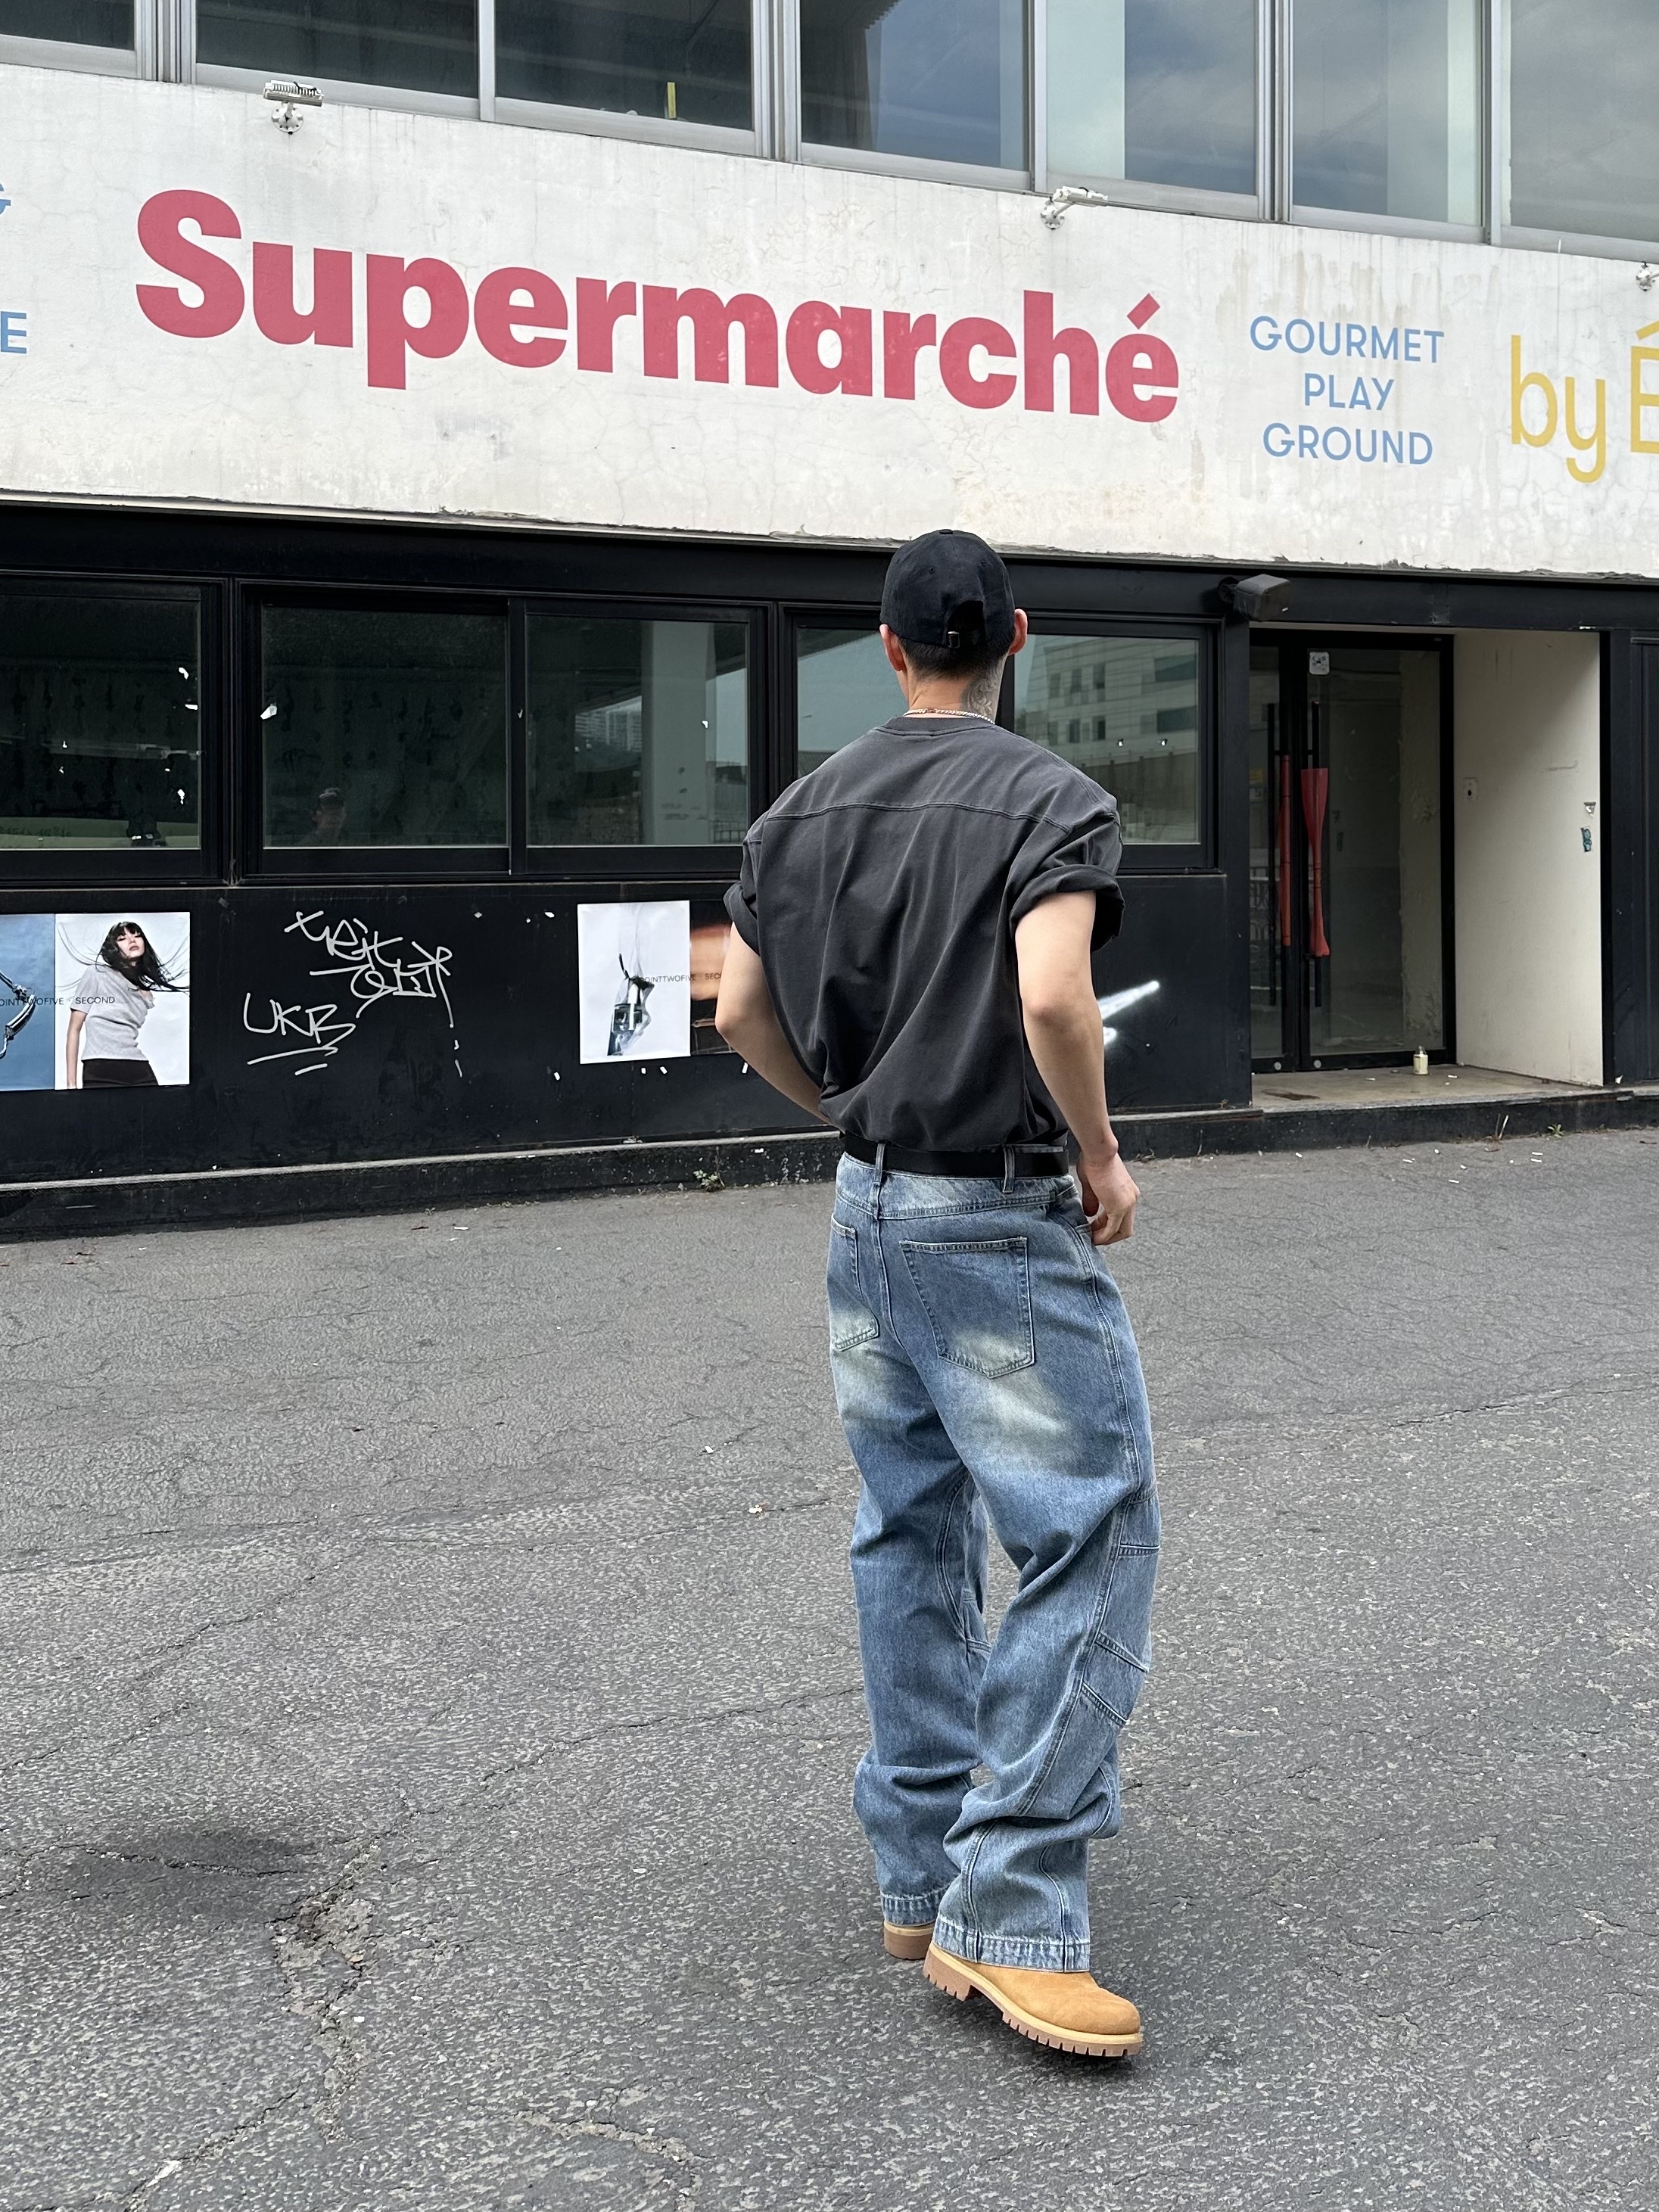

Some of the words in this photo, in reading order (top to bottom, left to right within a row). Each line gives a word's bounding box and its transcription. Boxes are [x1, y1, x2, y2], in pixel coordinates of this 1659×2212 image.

[136, 189, 1179, 423] Supermarché
[1250, 315, 1444, 363] GOURMET
[1304, 372, 1394, 410] PLAY
[1511, 334, 1607, 484] by
[1262, 422, 1433, 465] GROUND
[640, 973, 696, 983] OINTTWOFIVE
[75, 996, 116, 1005] SECOND
